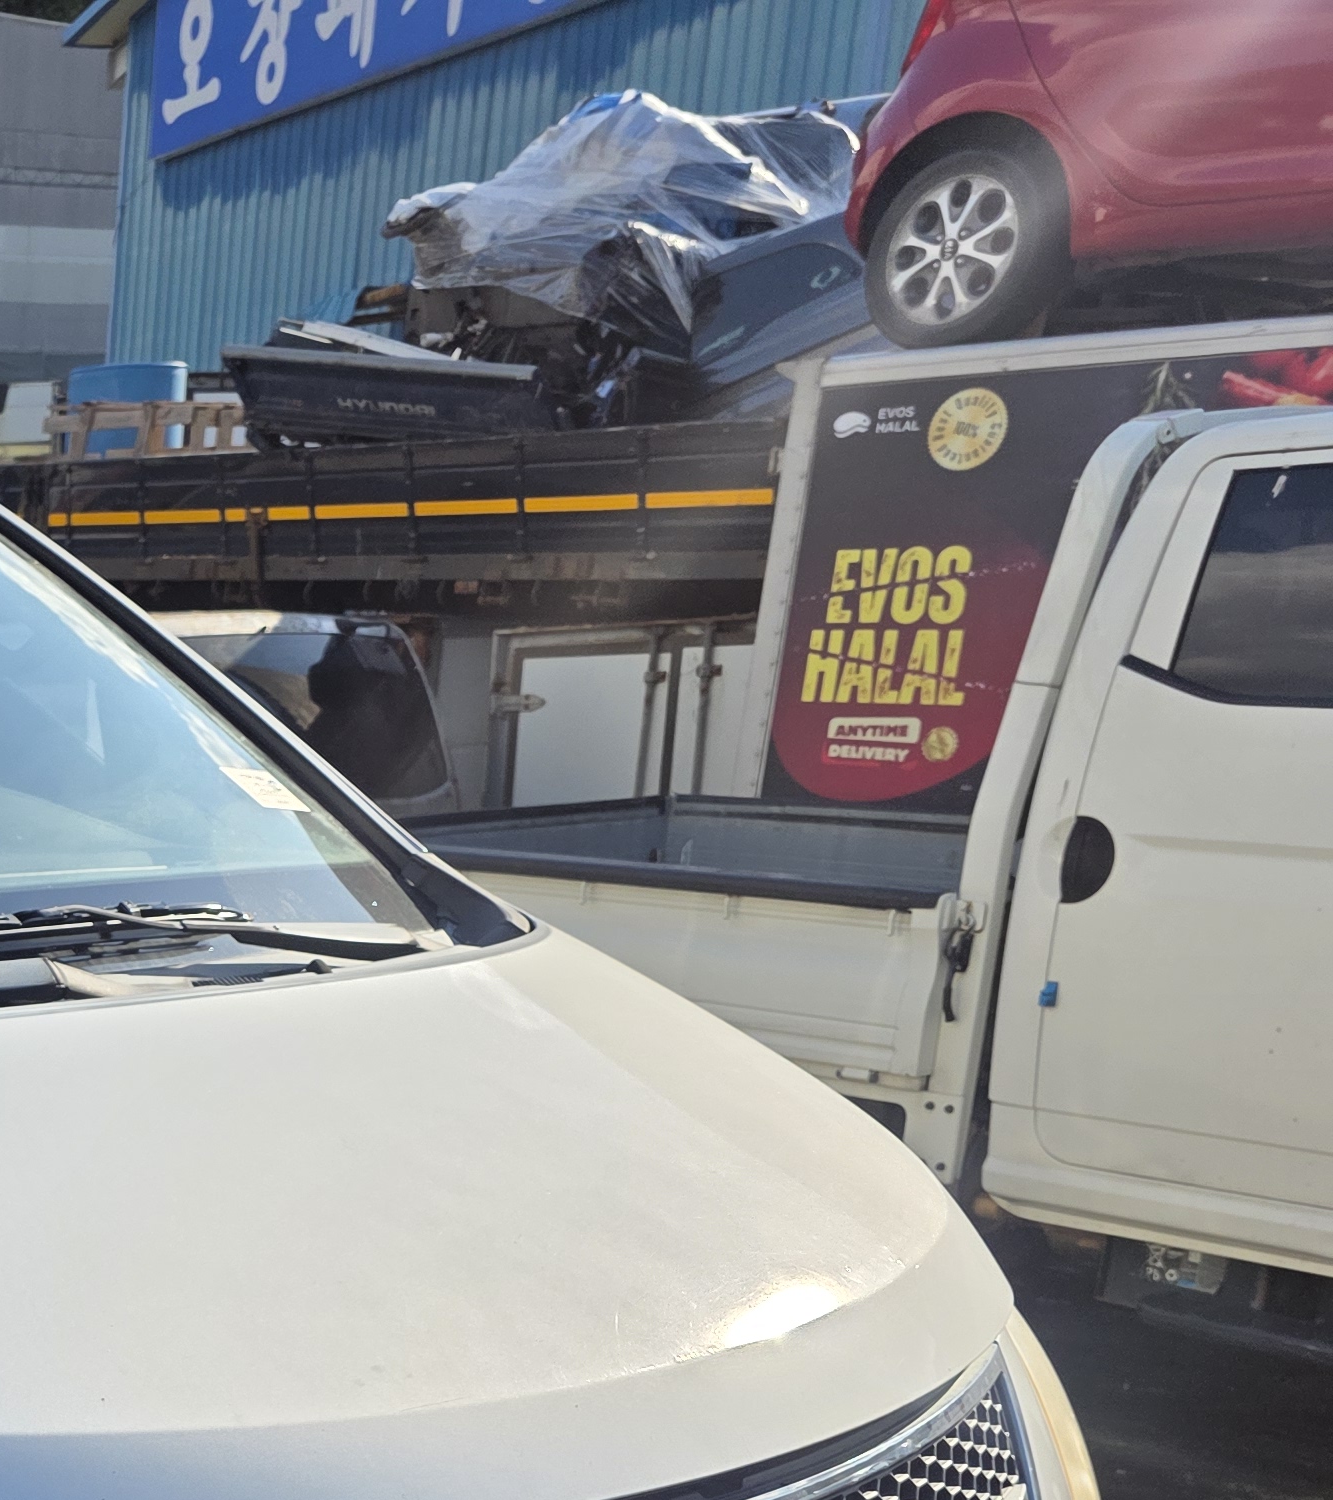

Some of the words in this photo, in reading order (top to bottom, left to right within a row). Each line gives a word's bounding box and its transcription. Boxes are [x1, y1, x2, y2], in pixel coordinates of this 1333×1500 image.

[878, 406, 917, 420] EVOS
[875, 420, 920, 434] HALAL
[826, 545, 972, 624] EVOS
[801, 629, 965, 706] HALAL
[835, 724, 909, 738] ANYTIME
[827, 744, 910, 762] DELIVERY
